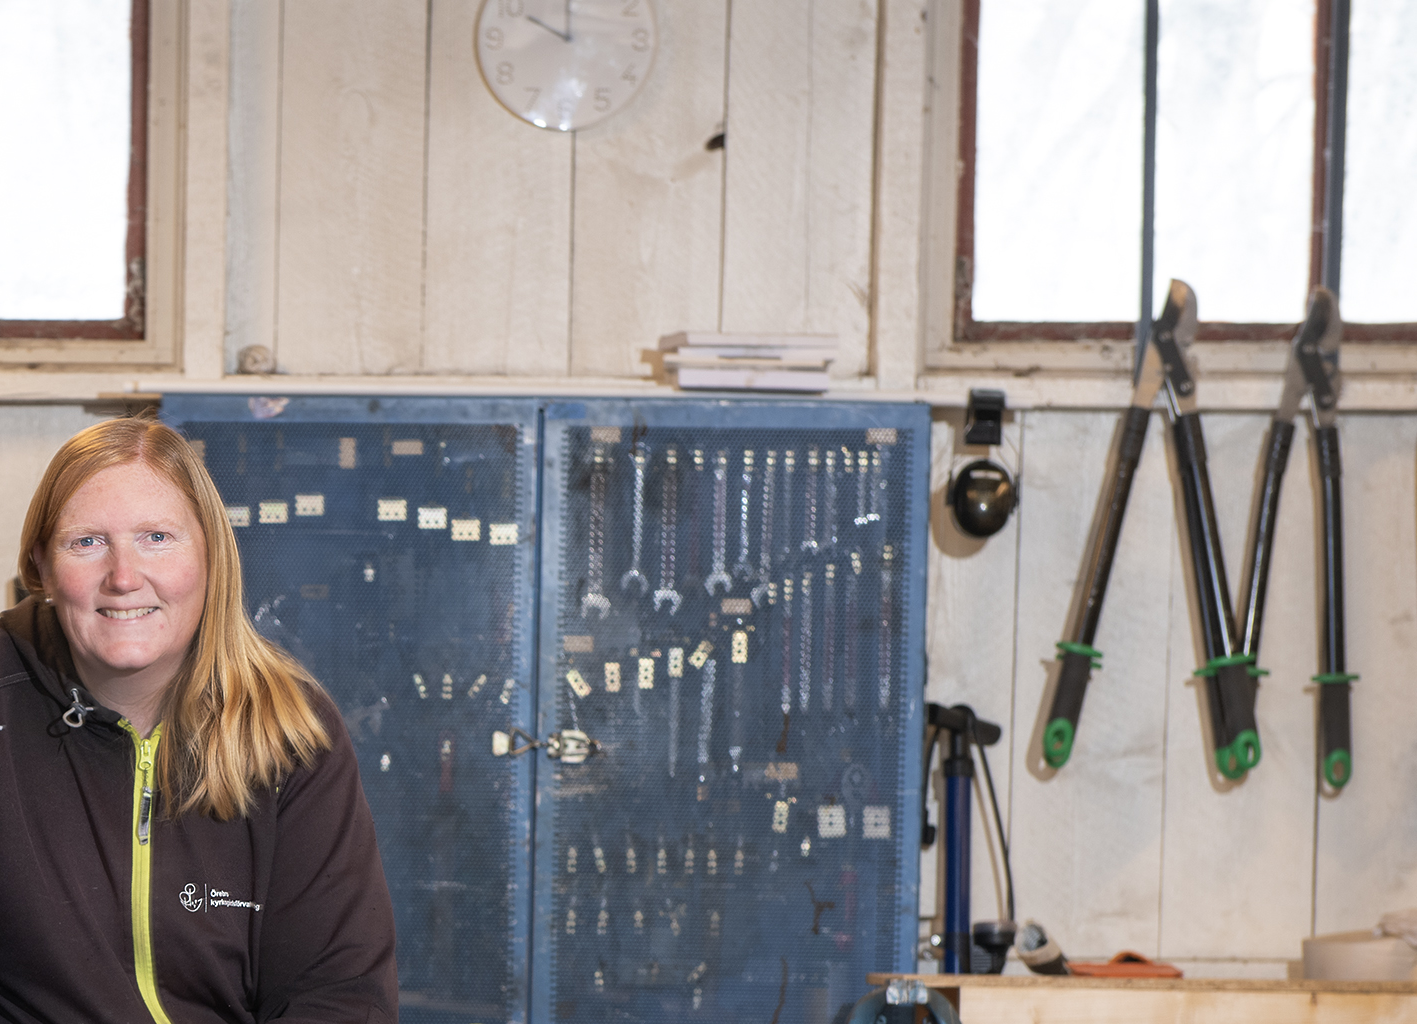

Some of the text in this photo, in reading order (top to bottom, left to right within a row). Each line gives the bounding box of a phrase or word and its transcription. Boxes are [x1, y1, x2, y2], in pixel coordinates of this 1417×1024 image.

[485, 27, 504, 50] 9
[633, 28, 649, 51] 3
[496, 62, 515, 86] 8
[593, 87, 611, 113] 5
